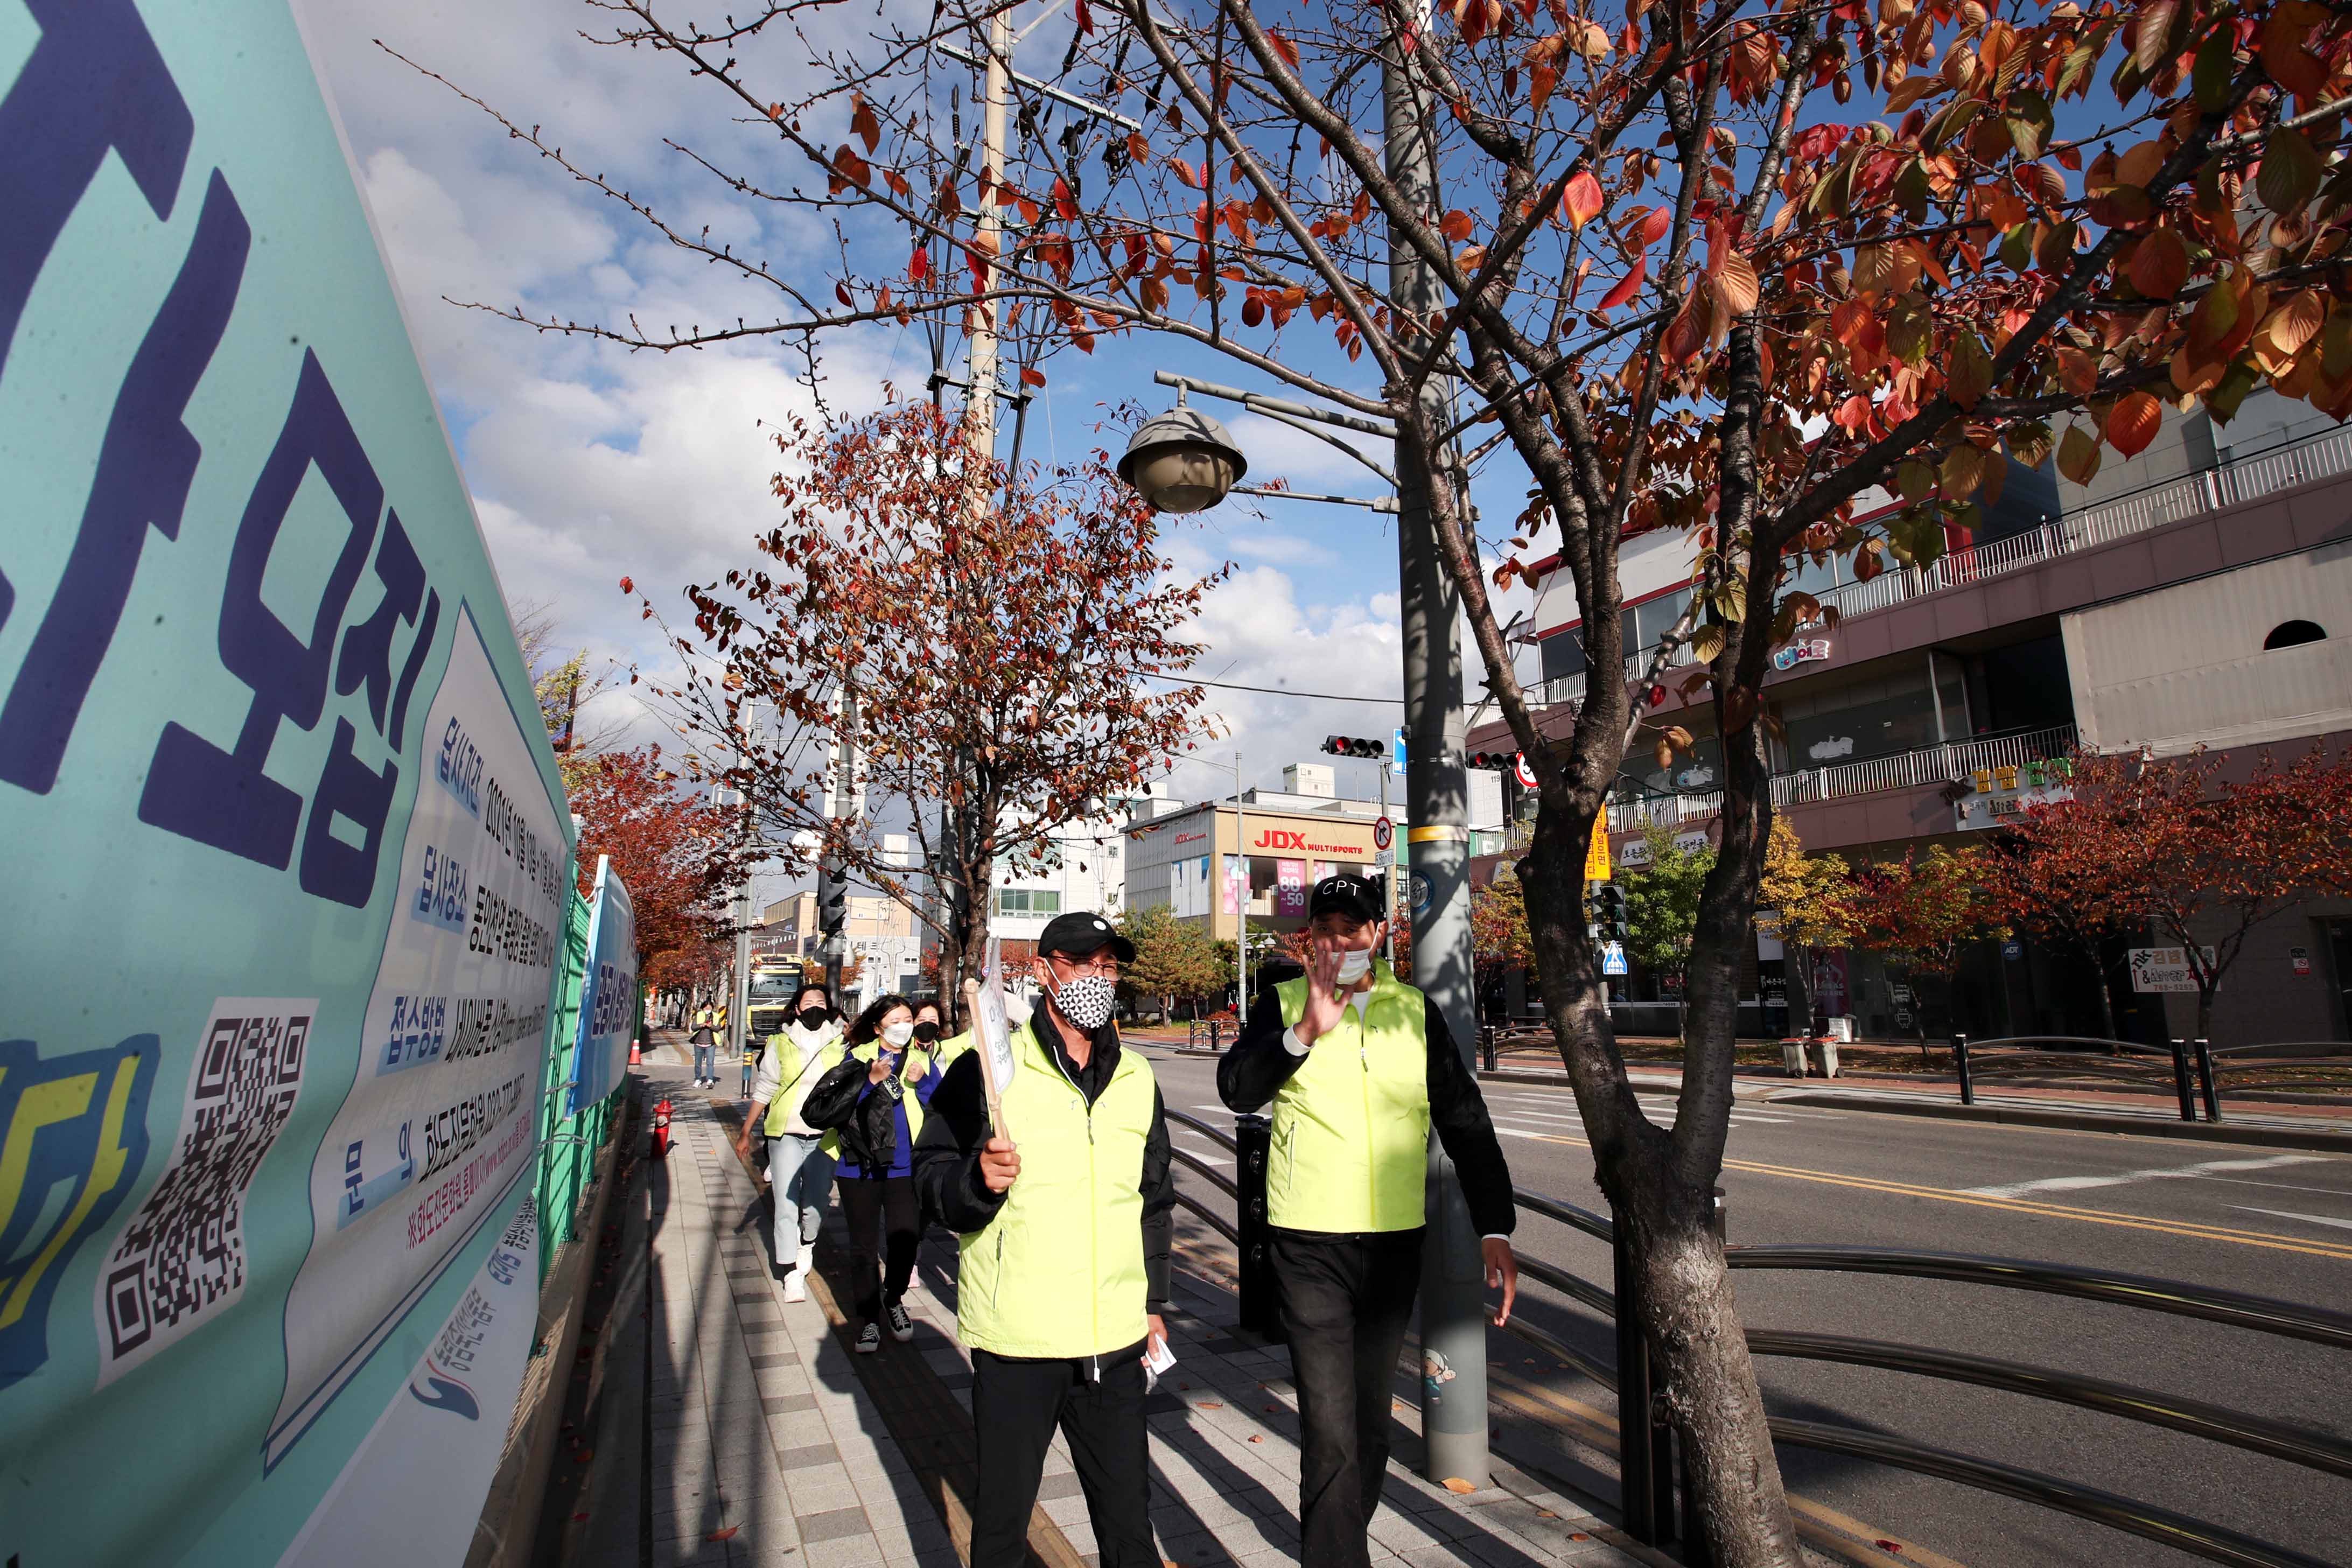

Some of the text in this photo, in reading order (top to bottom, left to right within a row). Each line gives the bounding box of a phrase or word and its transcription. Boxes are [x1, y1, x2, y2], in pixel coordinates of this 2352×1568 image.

[440, 716, 484, 813] 답사기간
[486, 778, 513, 857] 2021년
[514, 813, 526, 870] 10월
[1254, 830, 1363, 854] JDX MULTISPORTS
[419, 845, 467, 922] 답사장소
[470, 885, 507, 957] 동인천역
[1280, 876, 1300, 892] 80
[1322, 879, 1361, 896] CPT
[387, 996, 447, 1065] 접수방법
[445, 999, 493, 1063] 네이버폼
[418, 1093, 486, 1184] 화도진문화원
